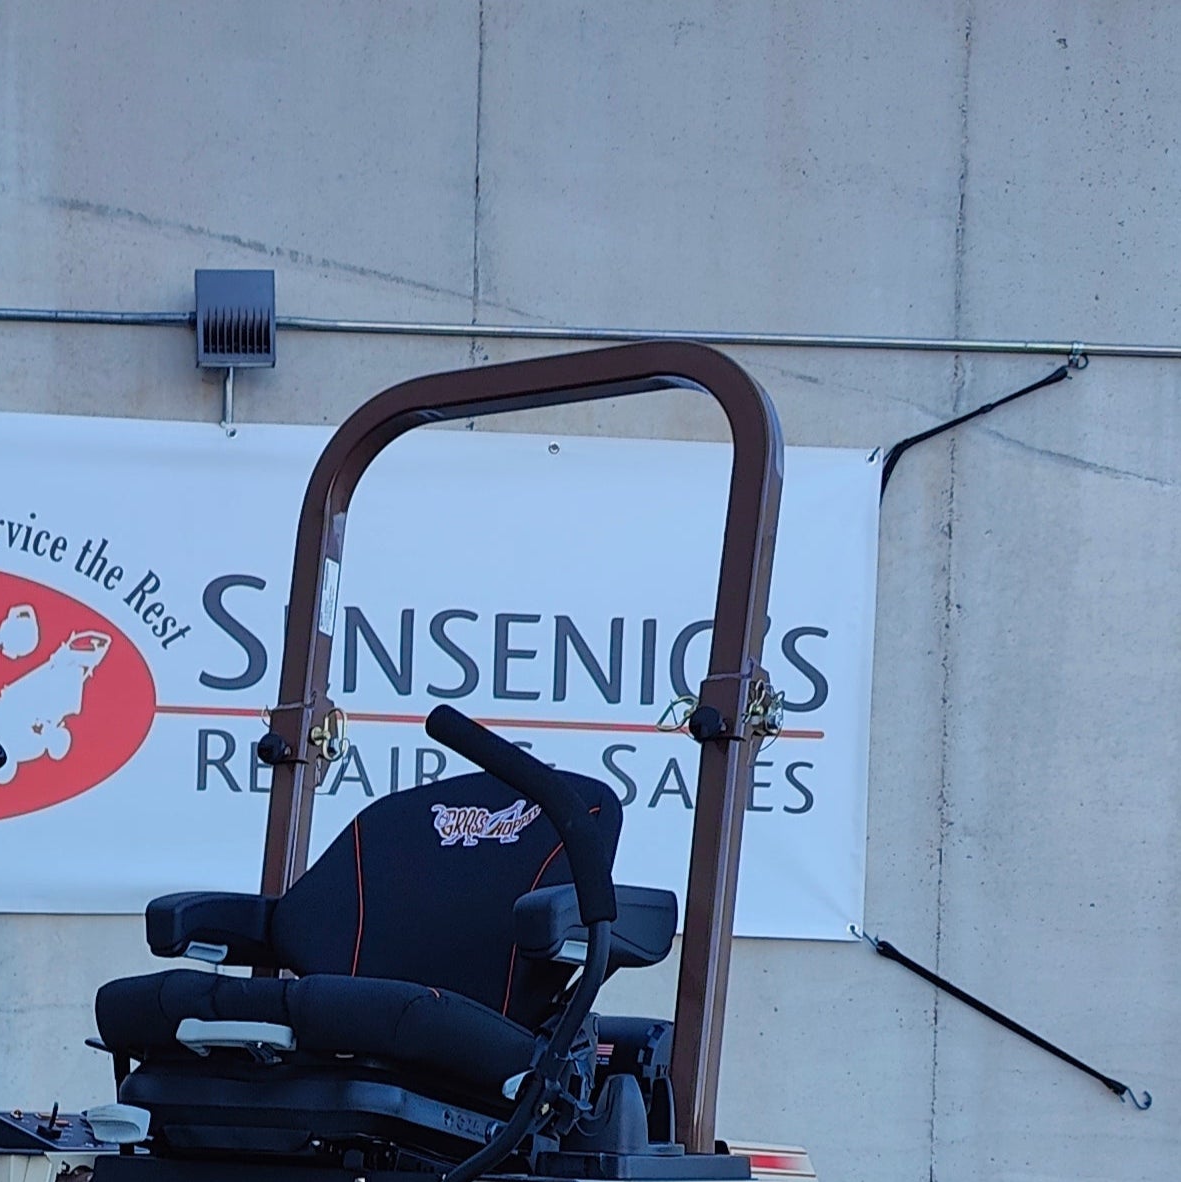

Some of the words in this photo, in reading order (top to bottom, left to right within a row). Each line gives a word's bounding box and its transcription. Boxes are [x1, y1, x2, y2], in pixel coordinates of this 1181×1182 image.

[74, 538, 124, 591] the
[122, 569, 192, 650] Rest
[198, 574, 829, 713] SNSENIS
[196, 728, 448, 798] REAIR
[601, 743, 815, 815] SAES
